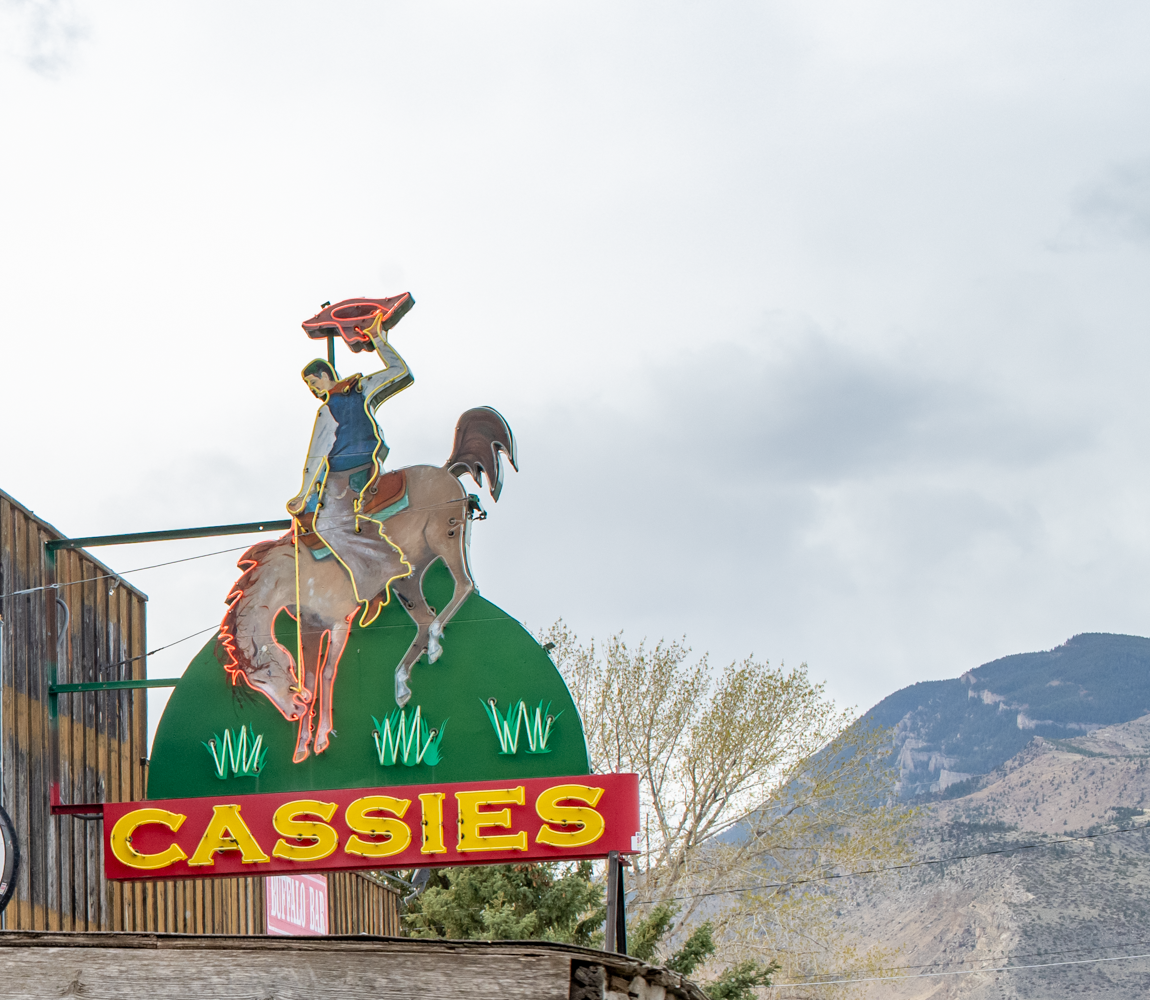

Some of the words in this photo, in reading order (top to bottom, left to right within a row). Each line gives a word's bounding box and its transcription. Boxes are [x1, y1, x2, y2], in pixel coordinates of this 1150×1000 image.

[109, 783, 606, 870] CASSIES
[270, 876, 306, 928] BUFFALO
[309, 886, 326, 935] BAR
